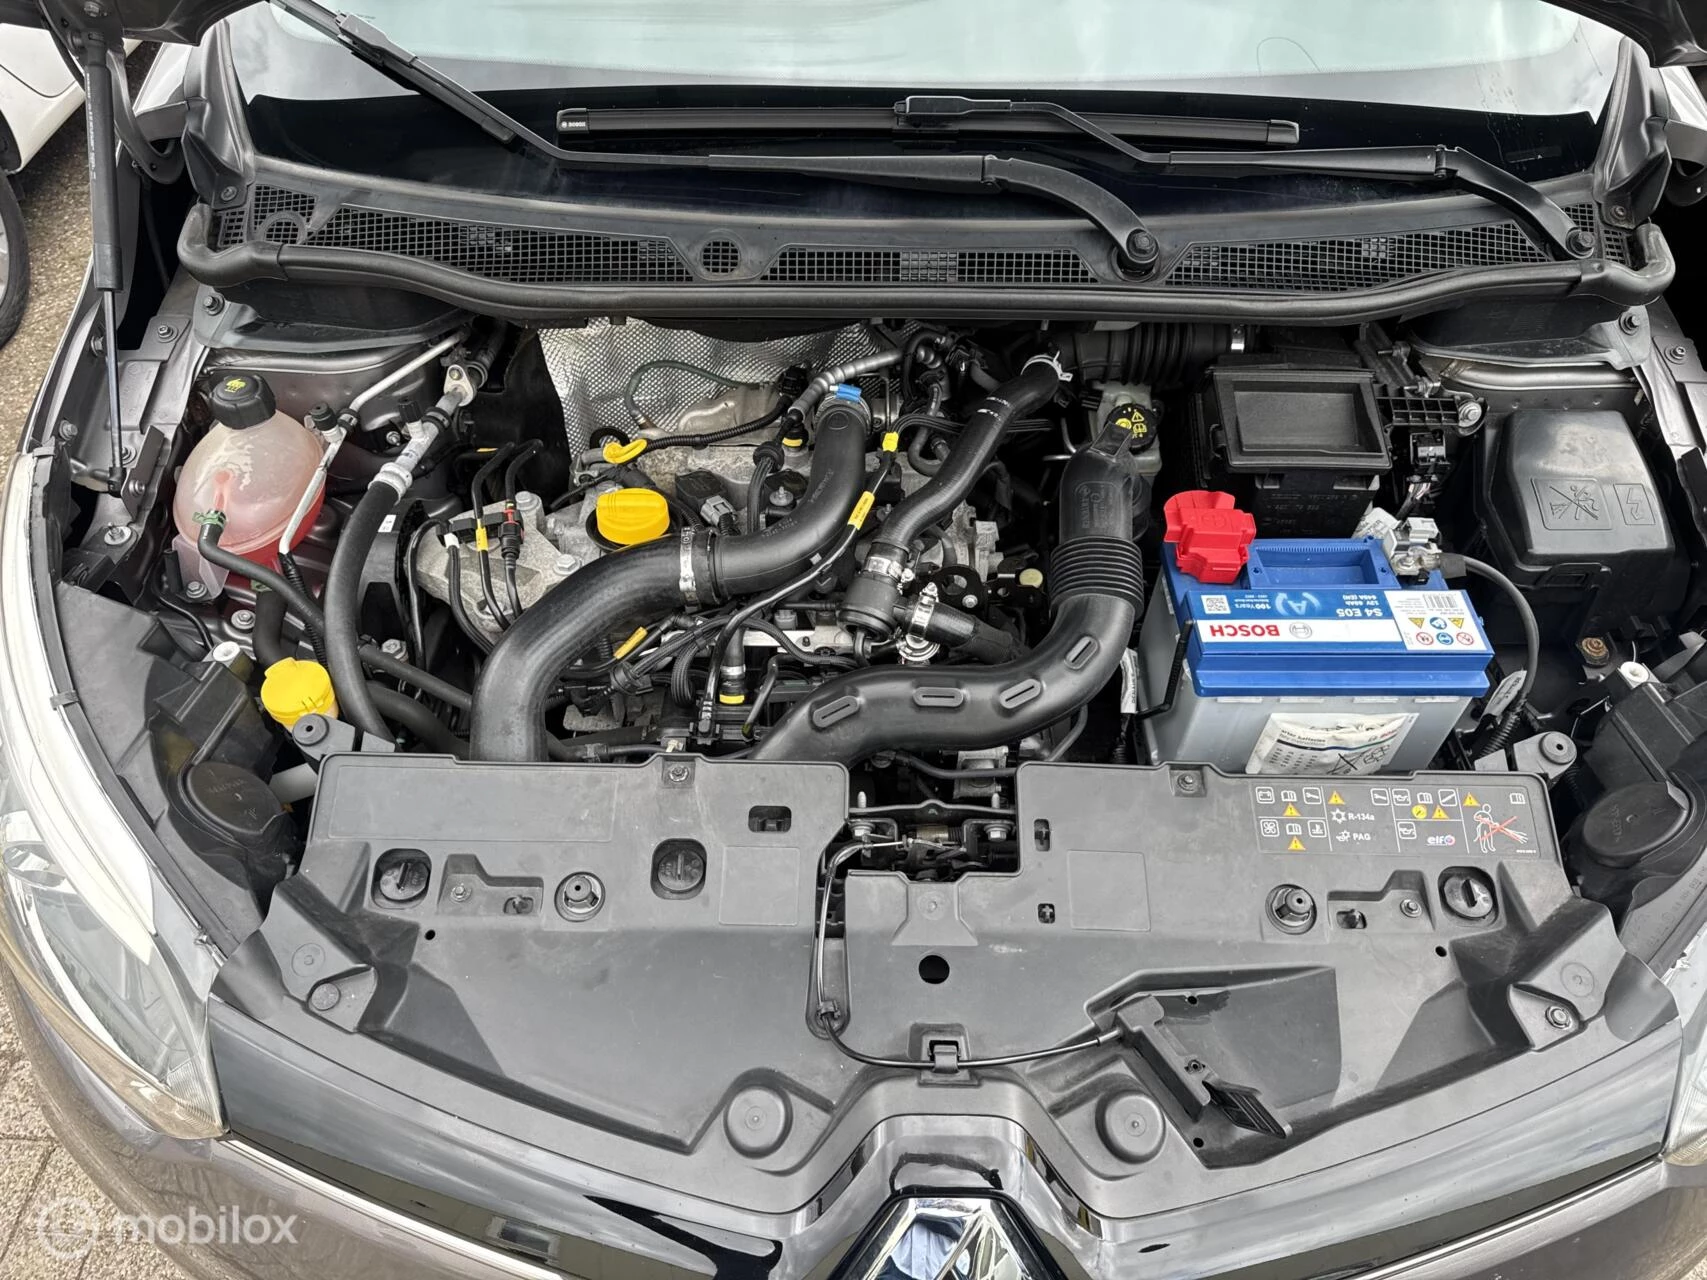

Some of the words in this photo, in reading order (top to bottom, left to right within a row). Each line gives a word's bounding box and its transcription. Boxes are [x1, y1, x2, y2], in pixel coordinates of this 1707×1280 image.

[1336, 608, 1362, 617] E05
[1364, 608, 1383, 617] S4
[1209, 624, 1281, 637] BOSCH
[1347, 813, 1375, 821] R-134a
[1353, 833, 1371, 841] PAG
